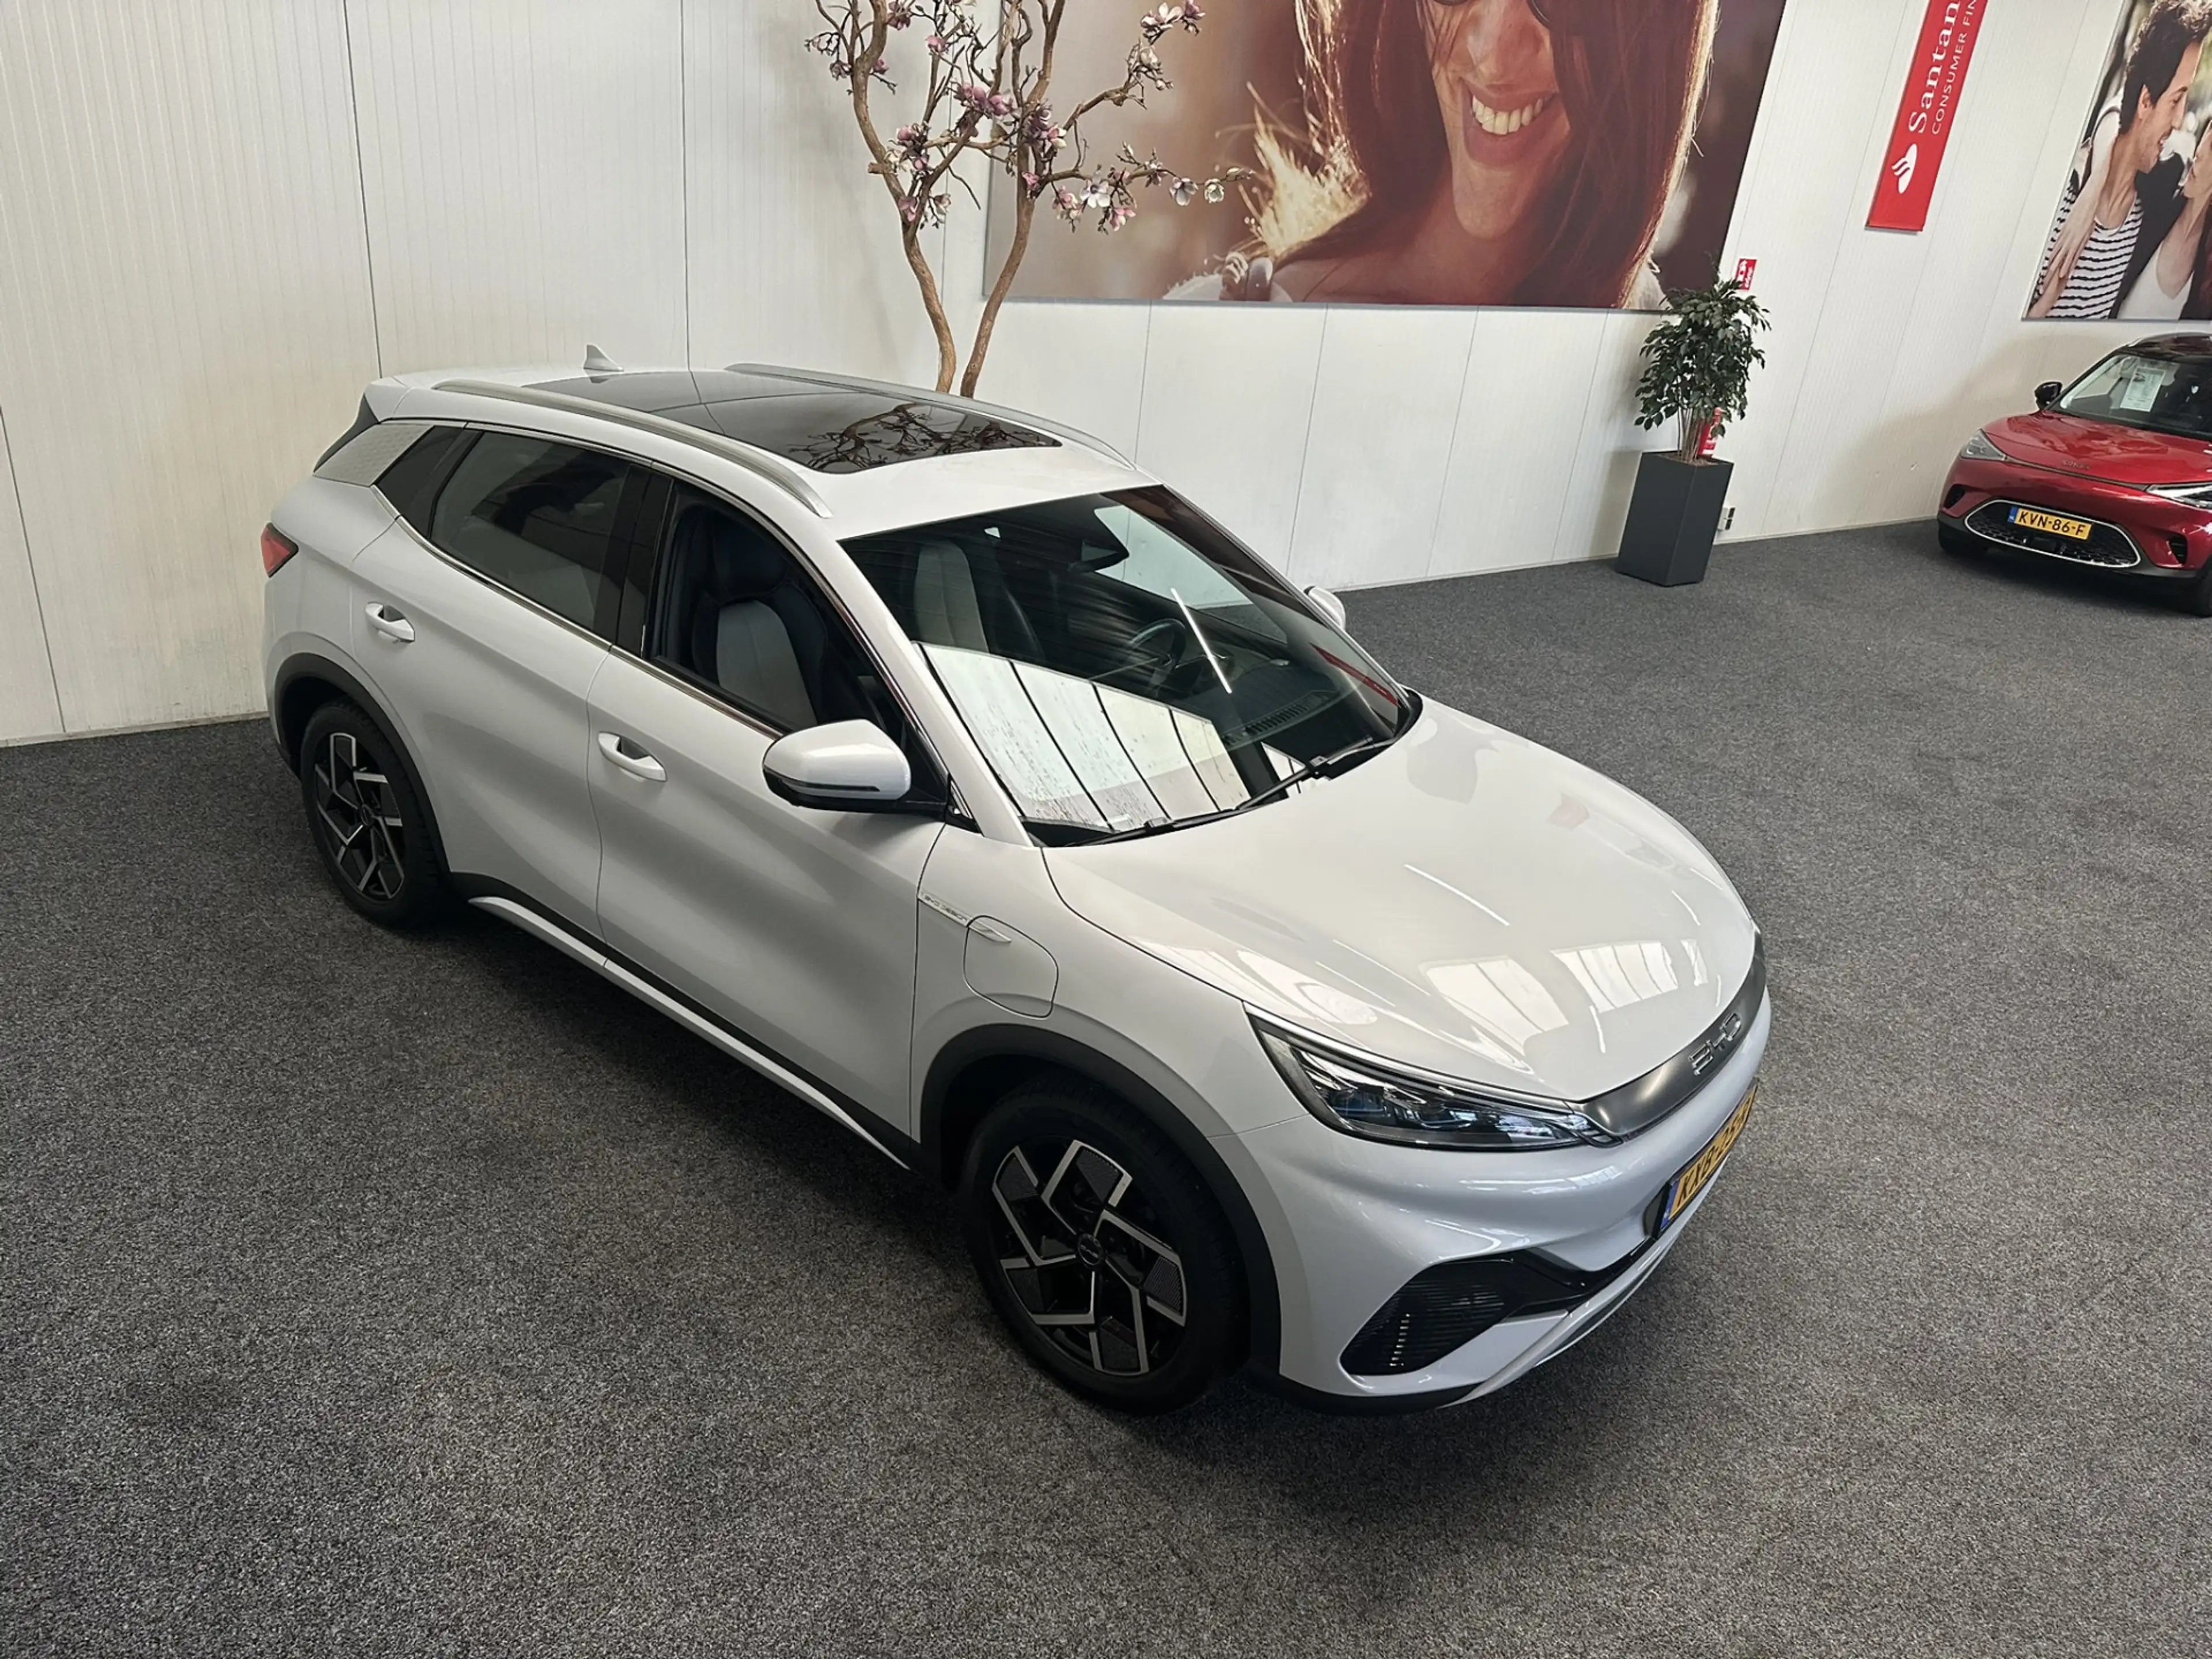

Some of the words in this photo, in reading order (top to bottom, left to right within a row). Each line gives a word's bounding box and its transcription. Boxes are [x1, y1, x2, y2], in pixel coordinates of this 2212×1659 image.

[1932, 33, 1967, 135] CONSUMER
[2018, 511, 2085, 535] KVN-86-F
[1688, 1013, 1741, 1076] BYD
